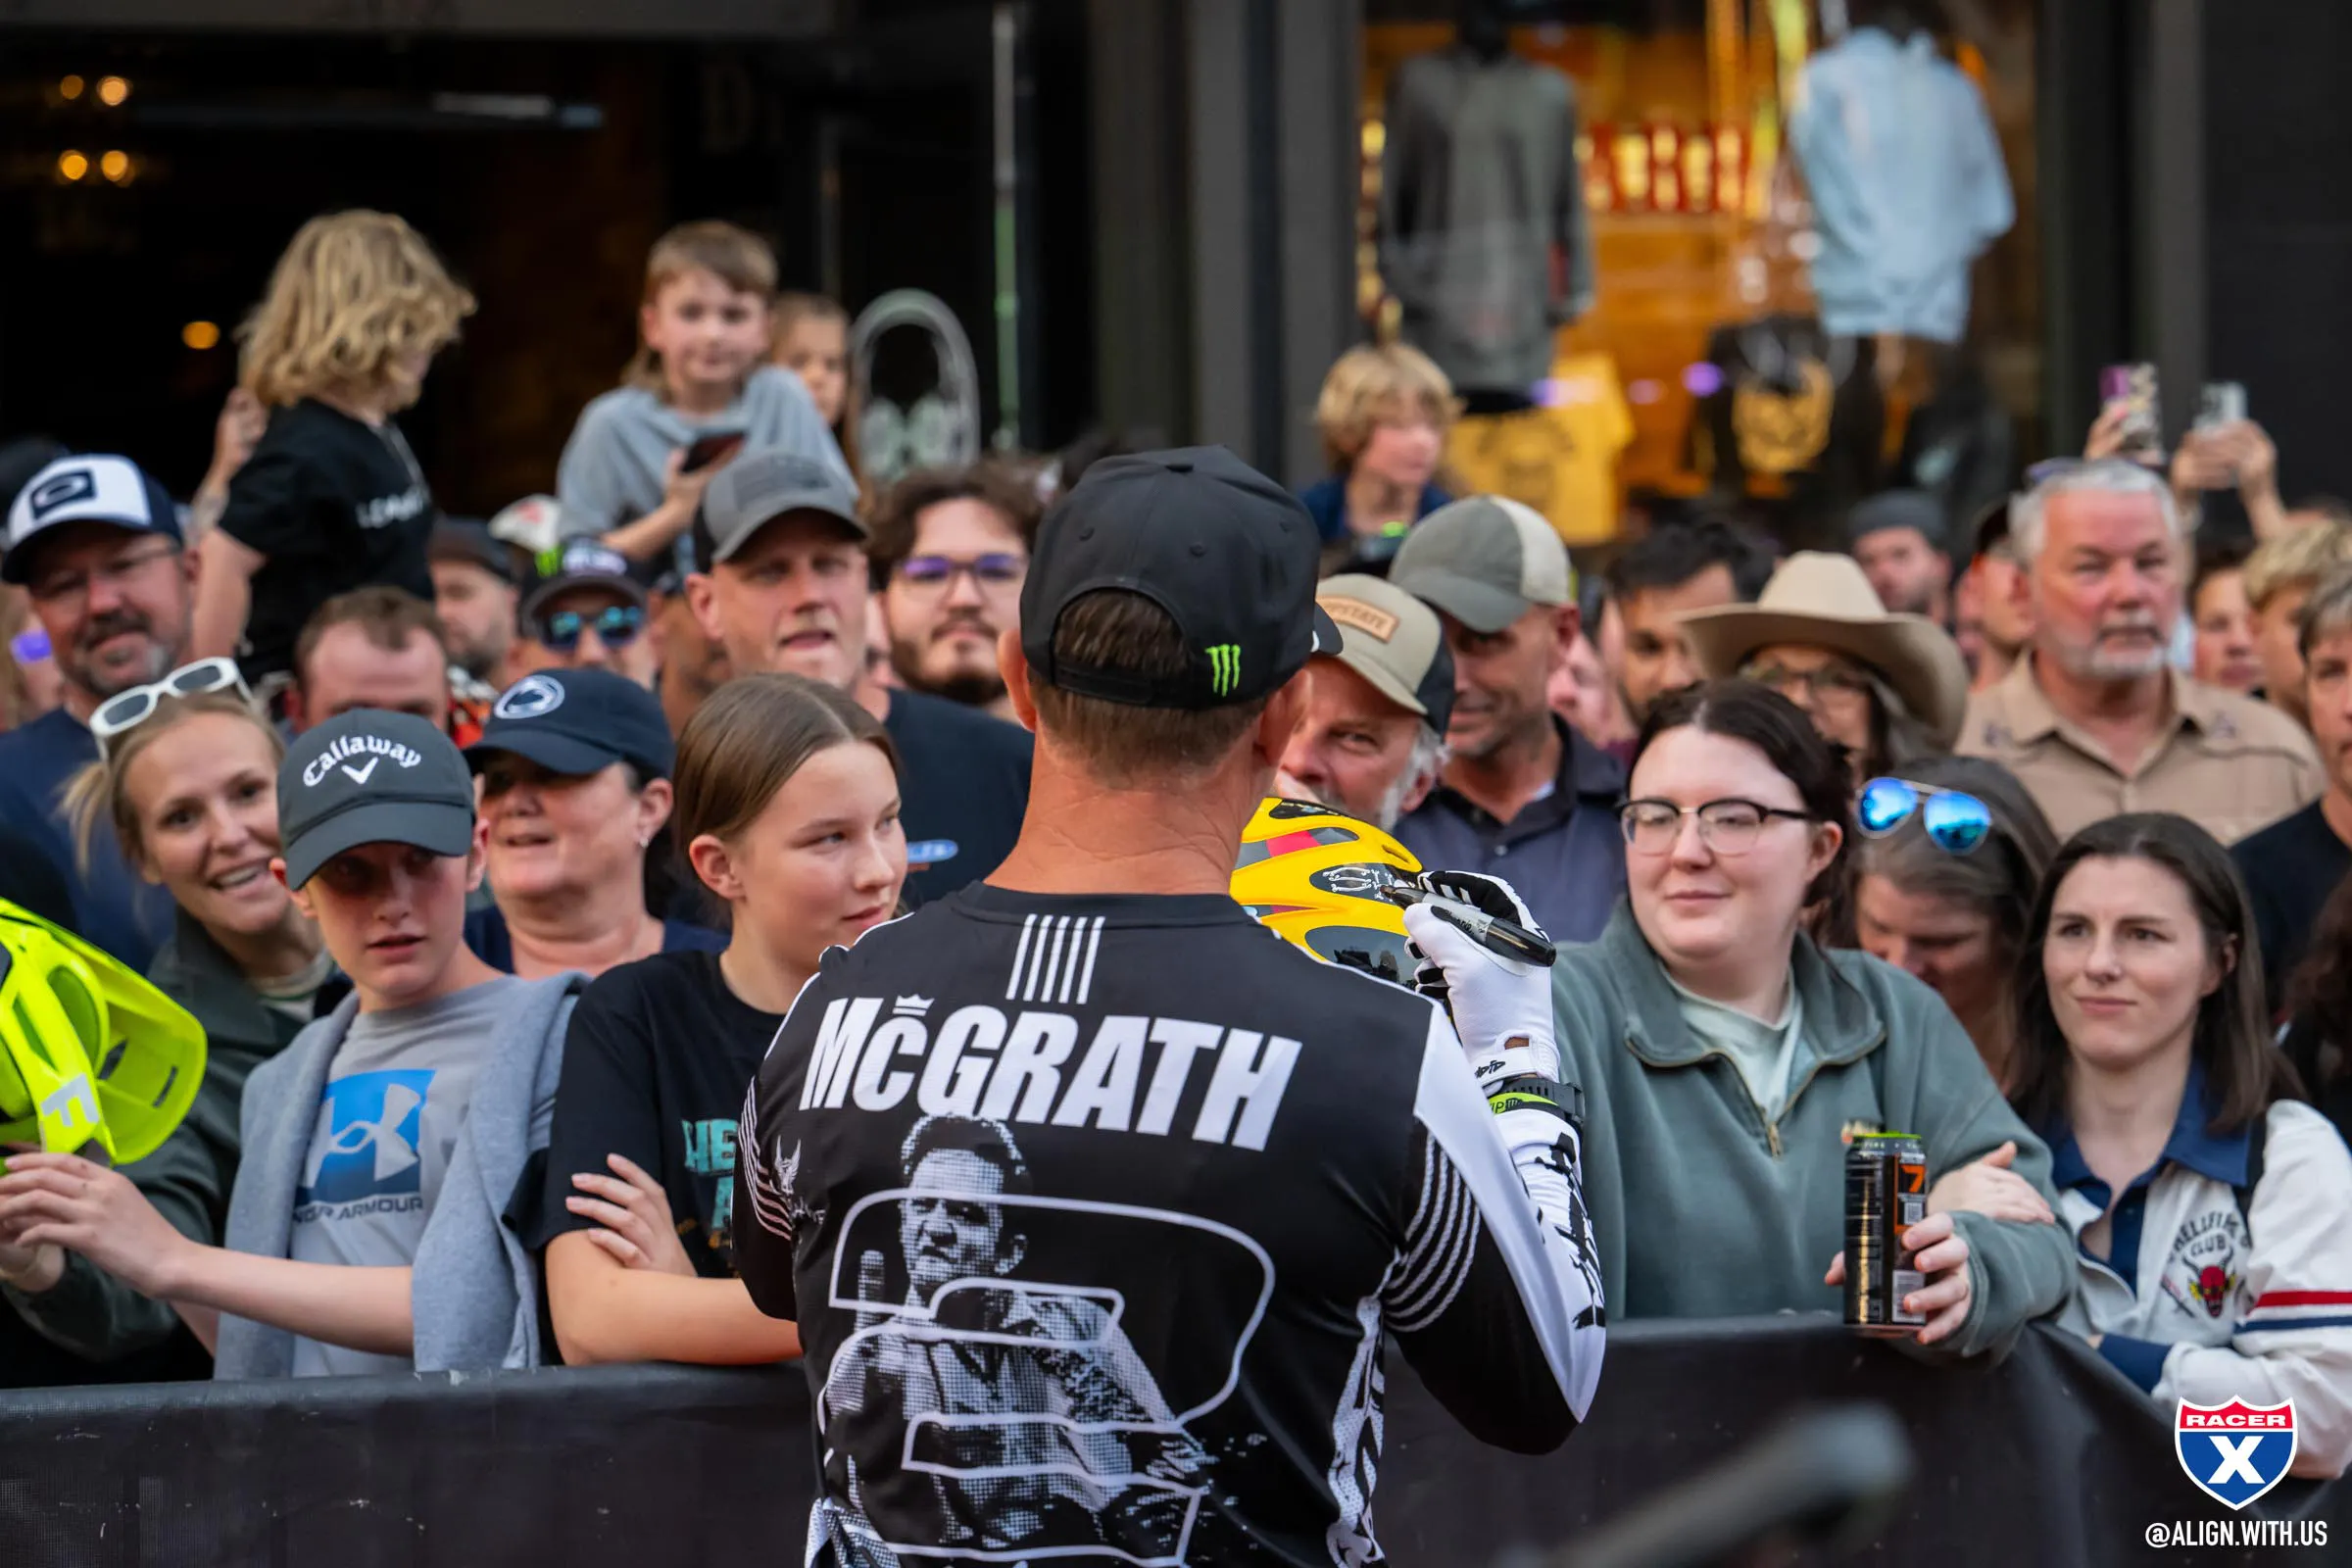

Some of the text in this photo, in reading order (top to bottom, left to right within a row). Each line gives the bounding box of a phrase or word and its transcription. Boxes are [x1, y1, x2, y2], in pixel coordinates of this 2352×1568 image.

[303, 734, 421, 787] Callaway
[337, 1198, 423, 1220] ARMOUR
[2191, 1235, 2226, 1256] CLUB
